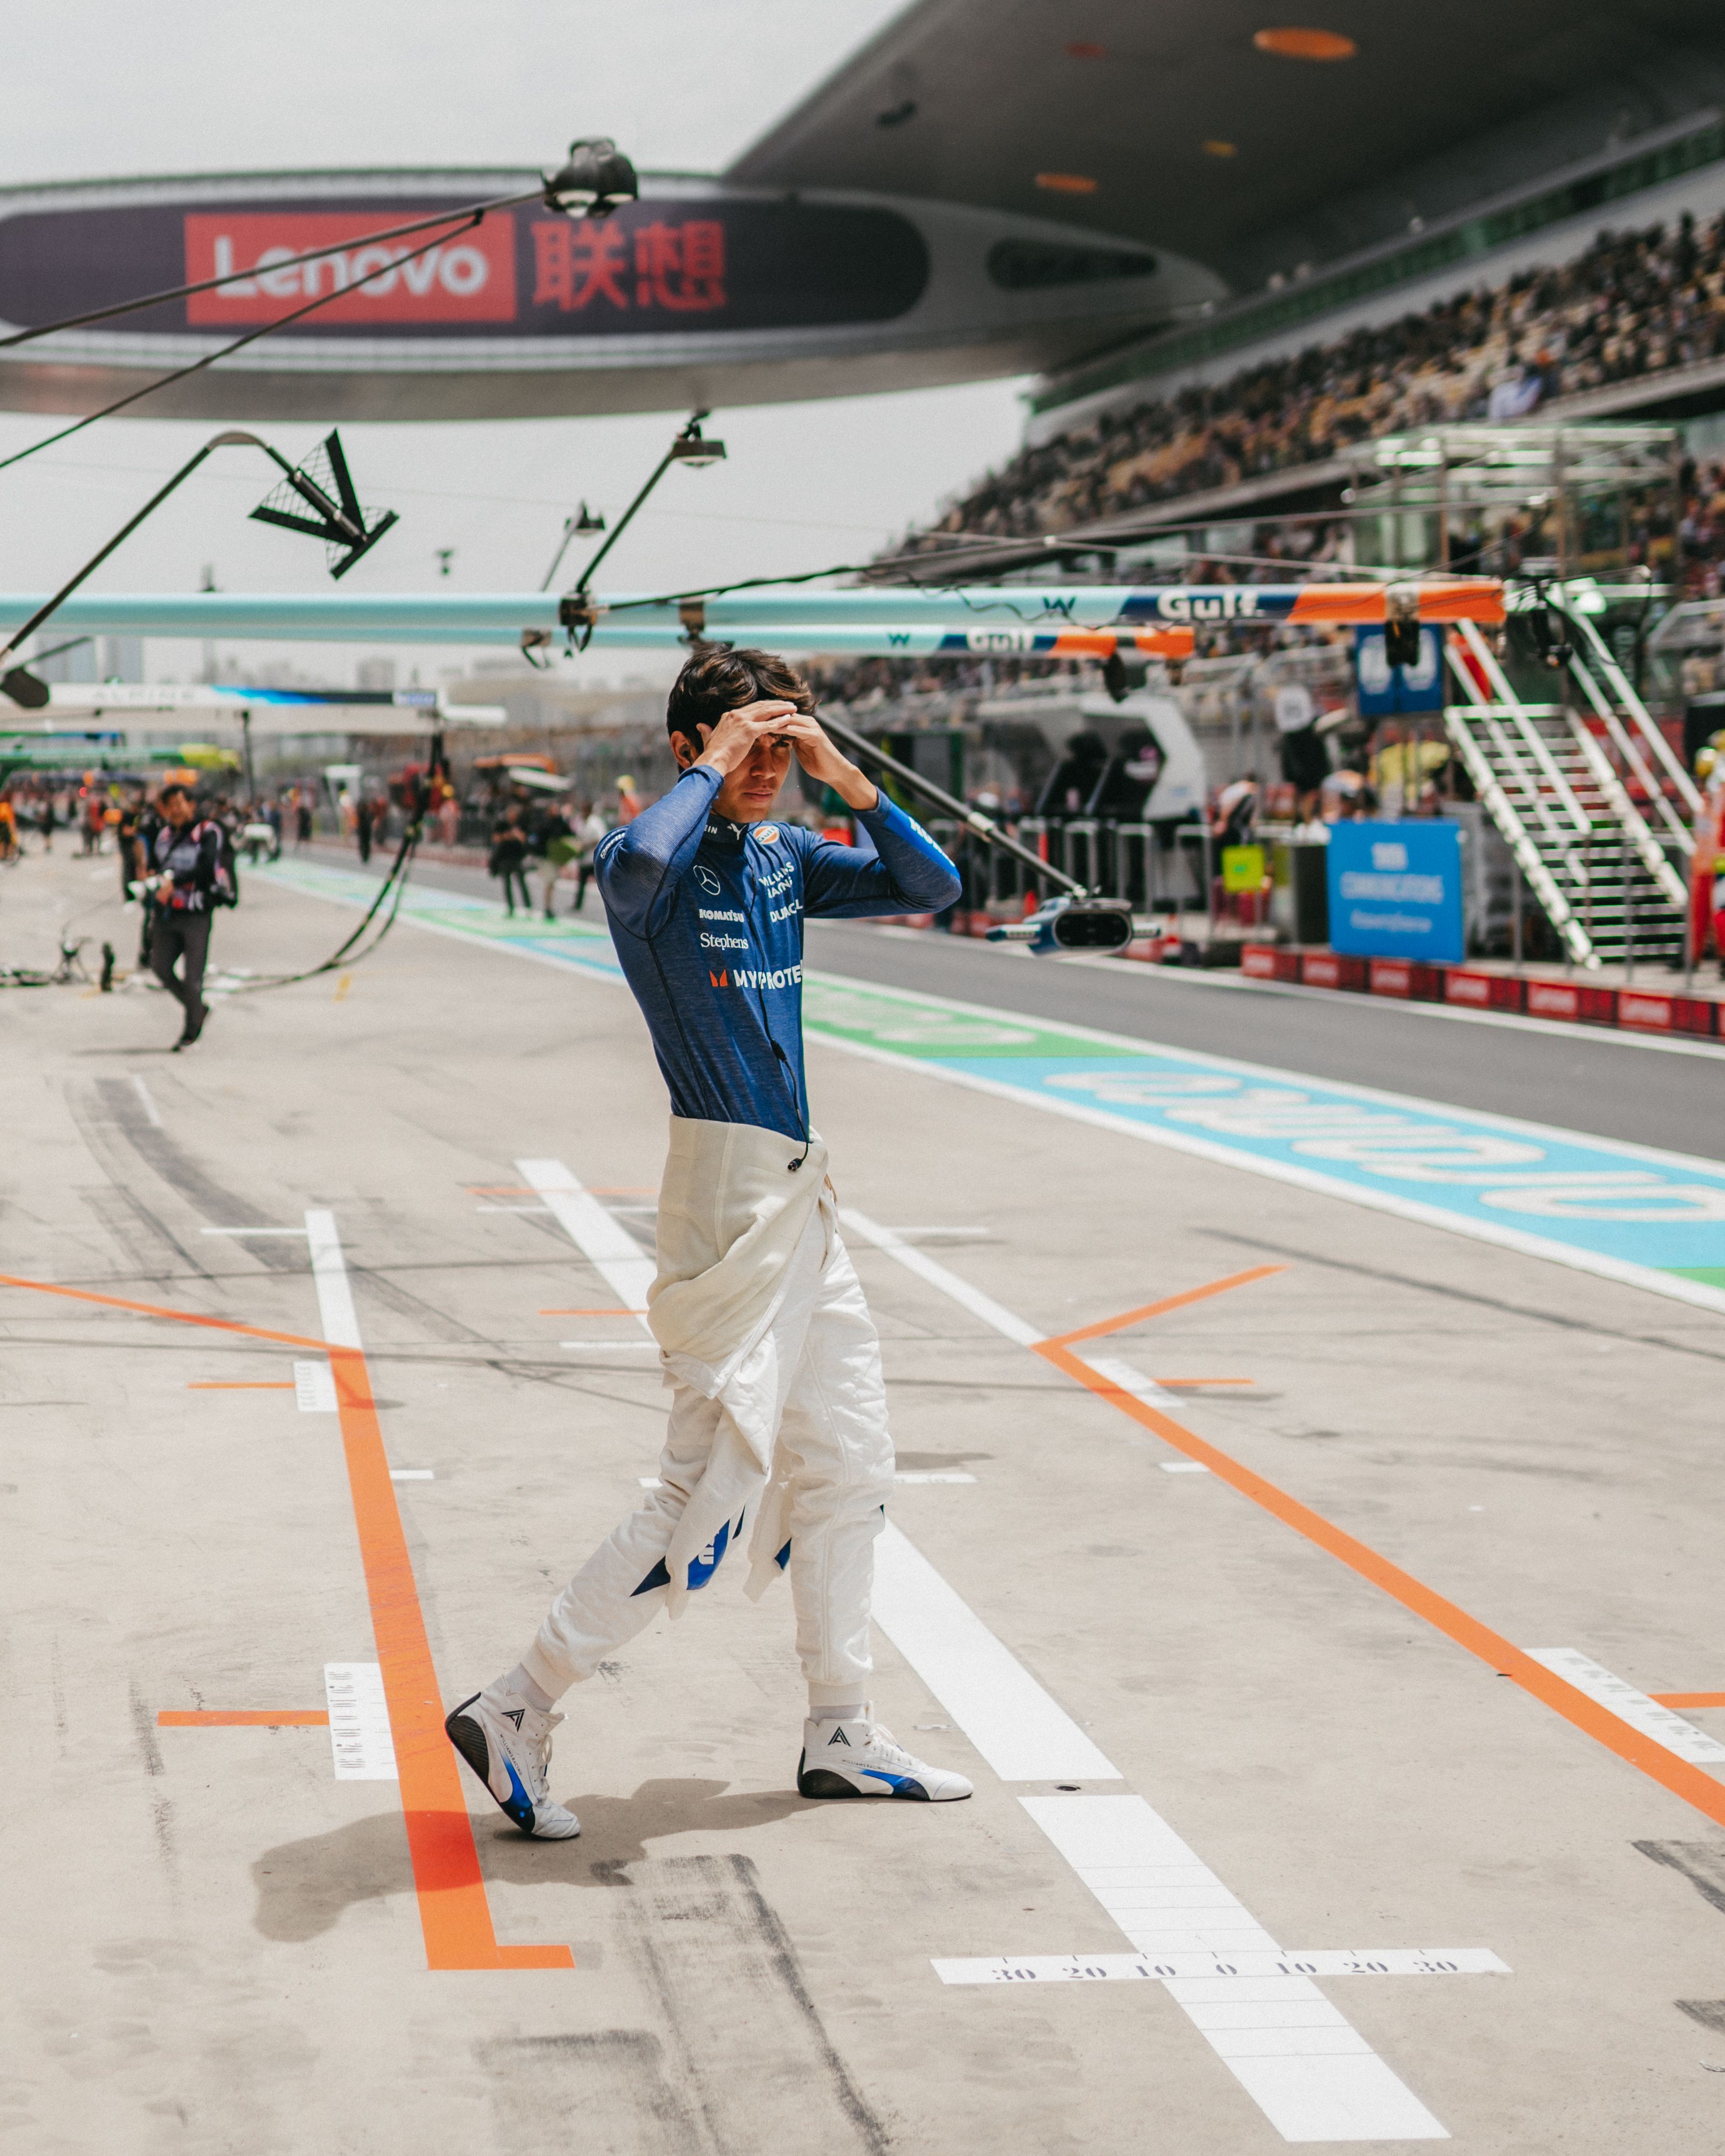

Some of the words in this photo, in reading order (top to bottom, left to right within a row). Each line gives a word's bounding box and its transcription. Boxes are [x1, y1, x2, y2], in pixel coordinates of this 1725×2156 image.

[215, 235, 488, 297] Lenovo
[530, 221, 726, 311] 联想
[1157, 589, 1258, 619] Gulf
[699, 909, 744, 923] KOMATSU
[700, 933, 748, 950] Stephens
[992, 1970, 1036, 1980] 30
[1062, 1967, 1106, 1979] 20
[1136, 1966, 1176, 1976] 10
[1216, 1965, 1237, 1974] 0
[1277, 1963, 1316, 1974] 10
[1343, 1963, 1388, 1973] 20
[1413, 1962, 1457, 1972] 30
